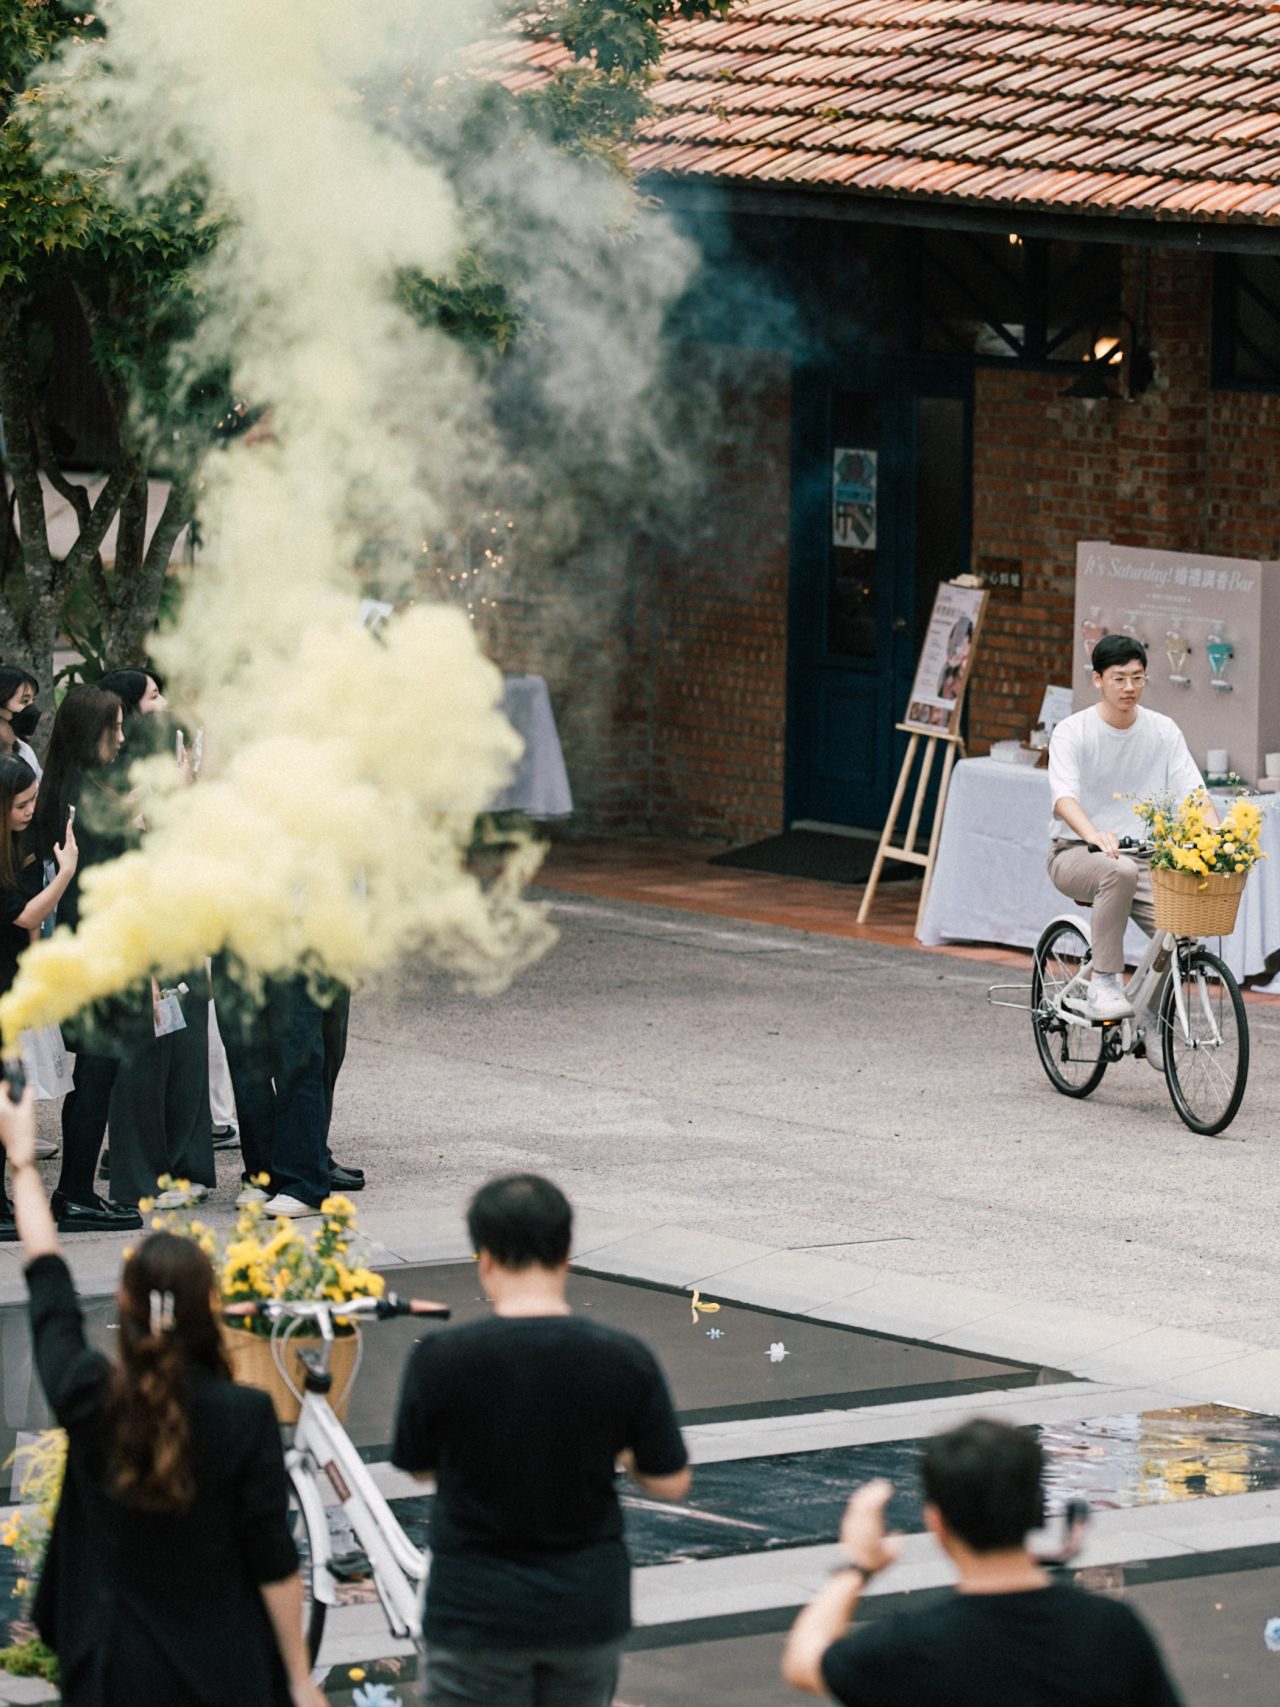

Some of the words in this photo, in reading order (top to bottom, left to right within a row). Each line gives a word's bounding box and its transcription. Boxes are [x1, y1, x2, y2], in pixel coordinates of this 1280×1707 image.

[1084, 555, 1105, 576] It's
[1108, 557, 1173, 588] Saturday!
[1229, 570, 1255, 592] Bar
